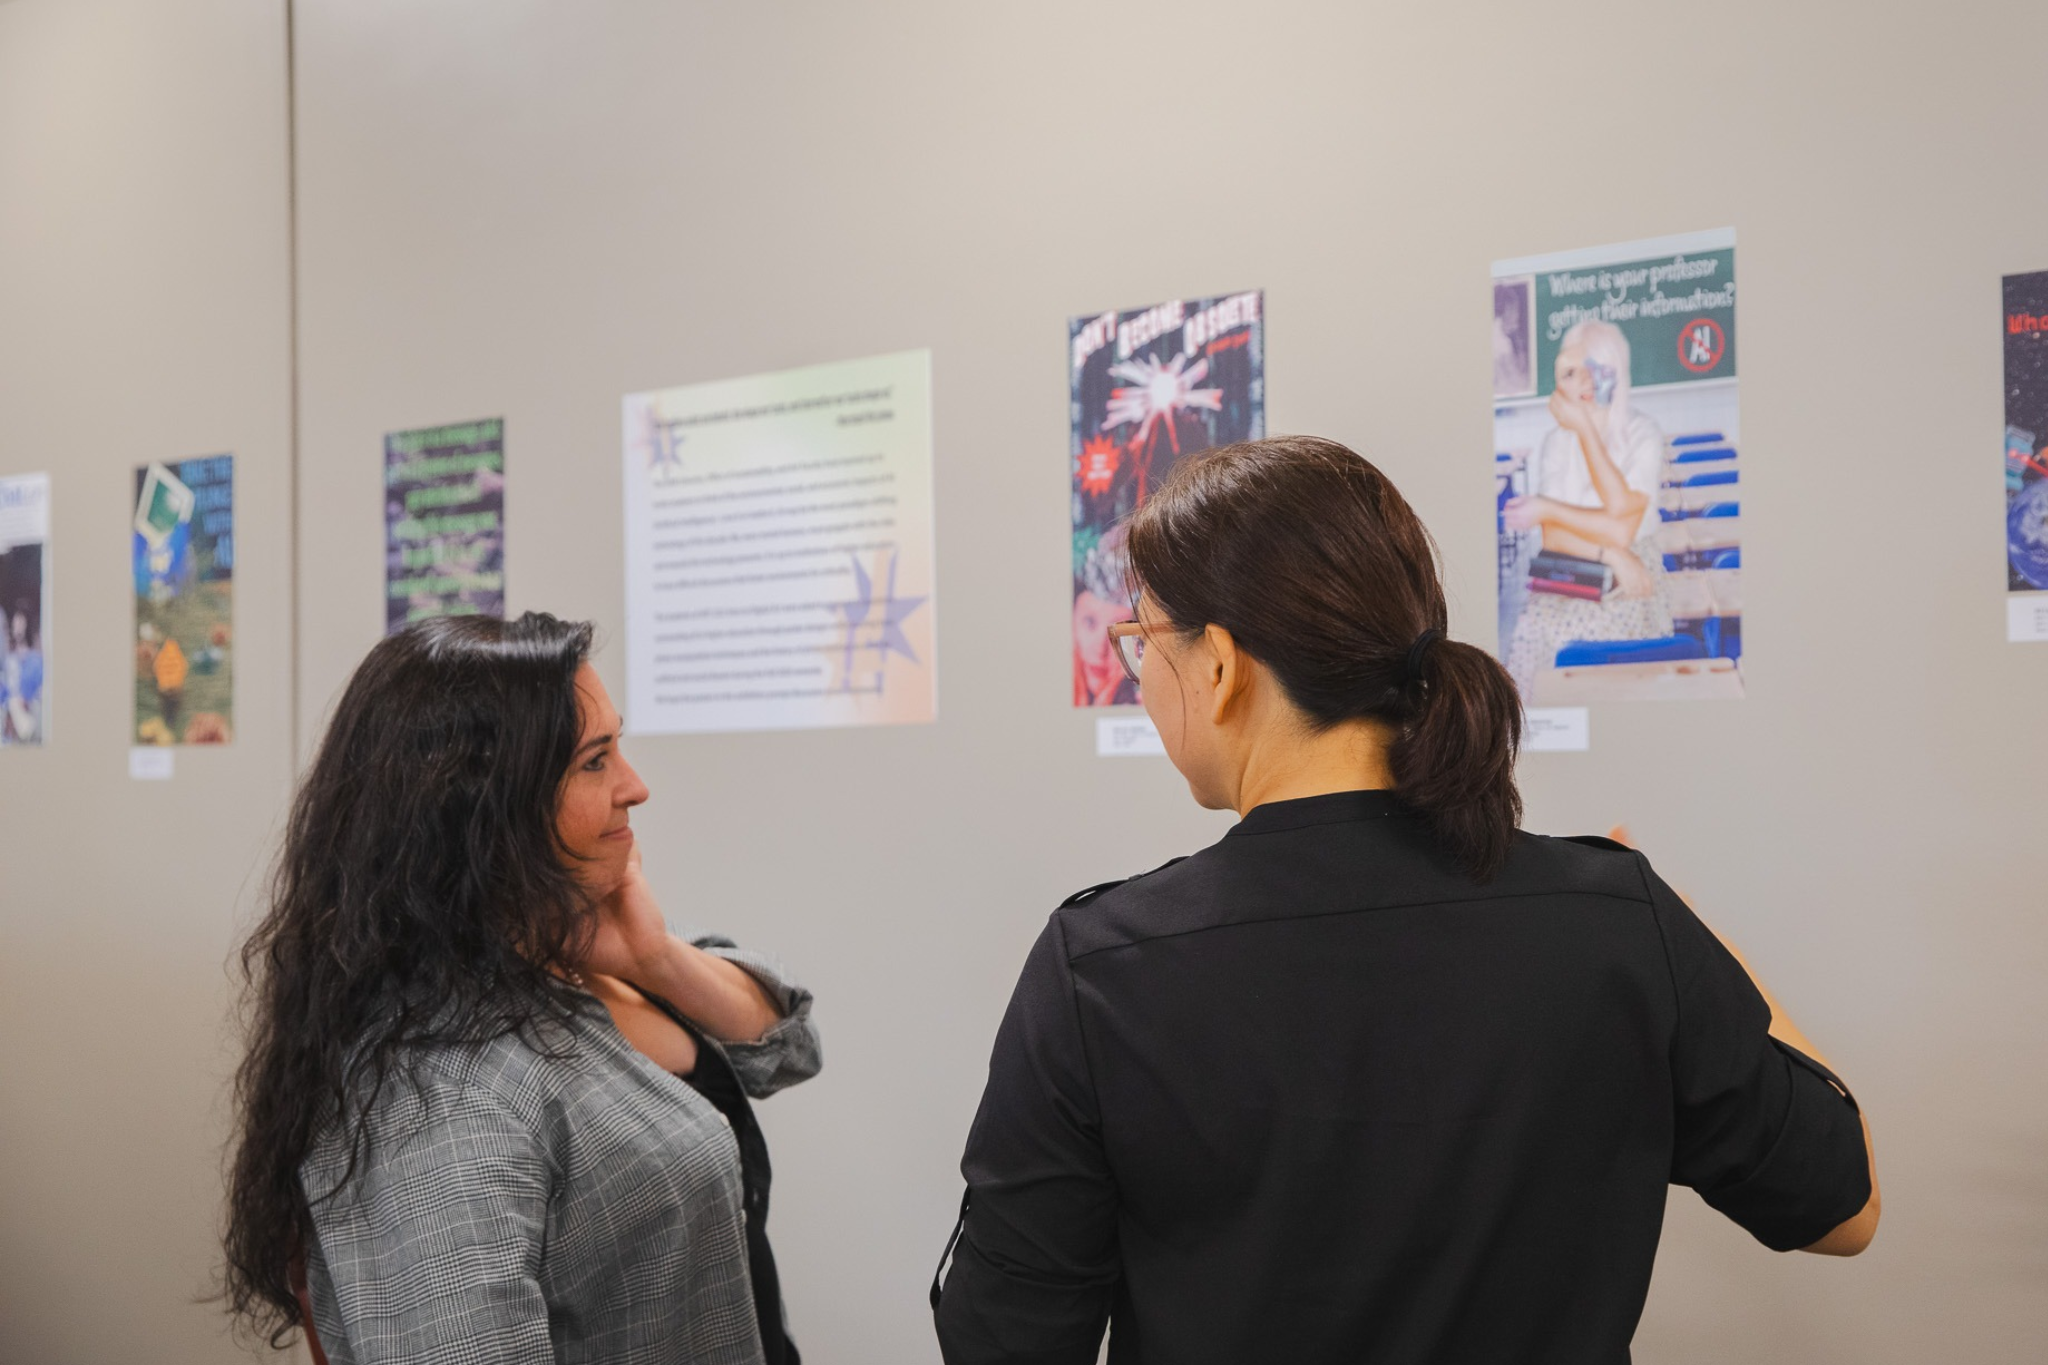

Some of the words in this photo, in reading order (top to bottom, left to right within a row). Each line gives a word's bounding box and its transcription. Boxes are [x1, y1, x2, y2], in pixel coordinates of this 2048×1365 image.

[1549, 272, 1596, 297] Where
[1598, 270, 1613, 289] is
[1606, 267, 1648, 302] your
[1650, 255, 1718, 294] professor
[1601, 301, 1639, 321] their
[1641, 282, 1735, 318] information?
